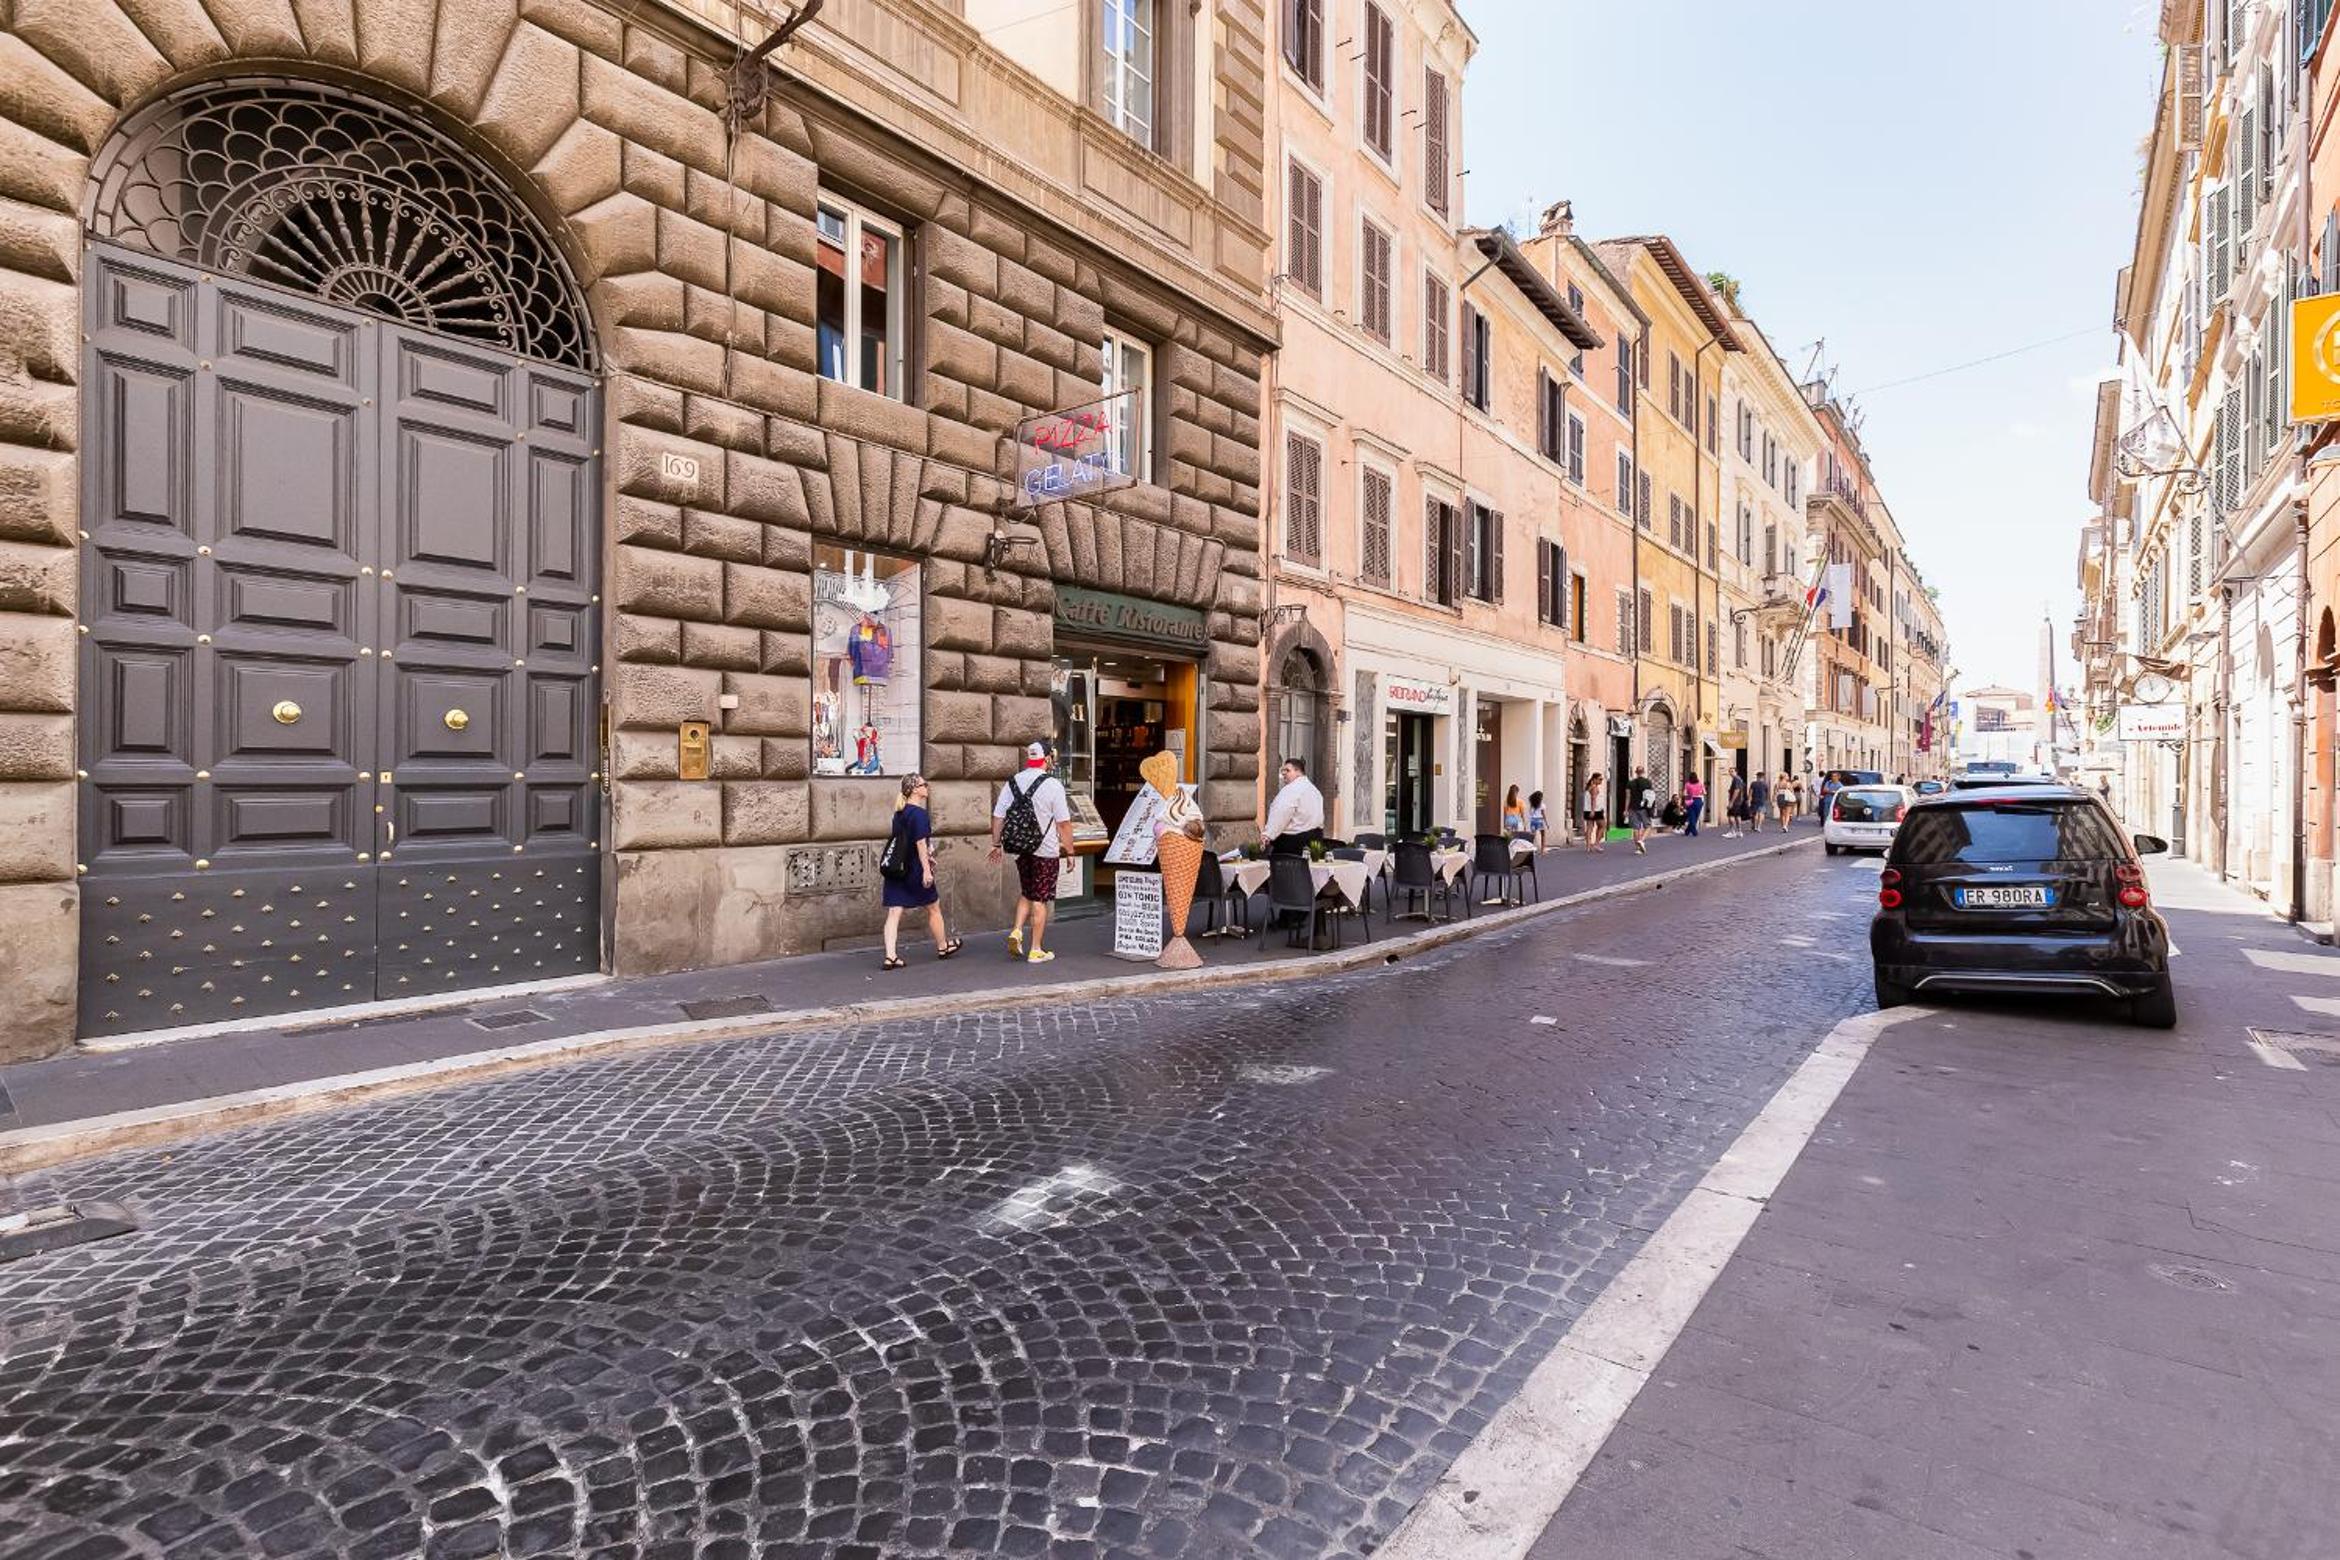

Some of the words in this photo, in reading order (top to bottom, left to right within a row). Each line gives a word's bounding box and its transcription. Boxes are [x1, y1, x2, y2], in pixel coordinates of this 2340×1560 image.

[1034, 411, 1110, 455] PIZZA
[665, 455, 695, 479] 169
[2138, 723, 2182, 732] Artemide
[1134, 892, 1160, 903] TONIC
